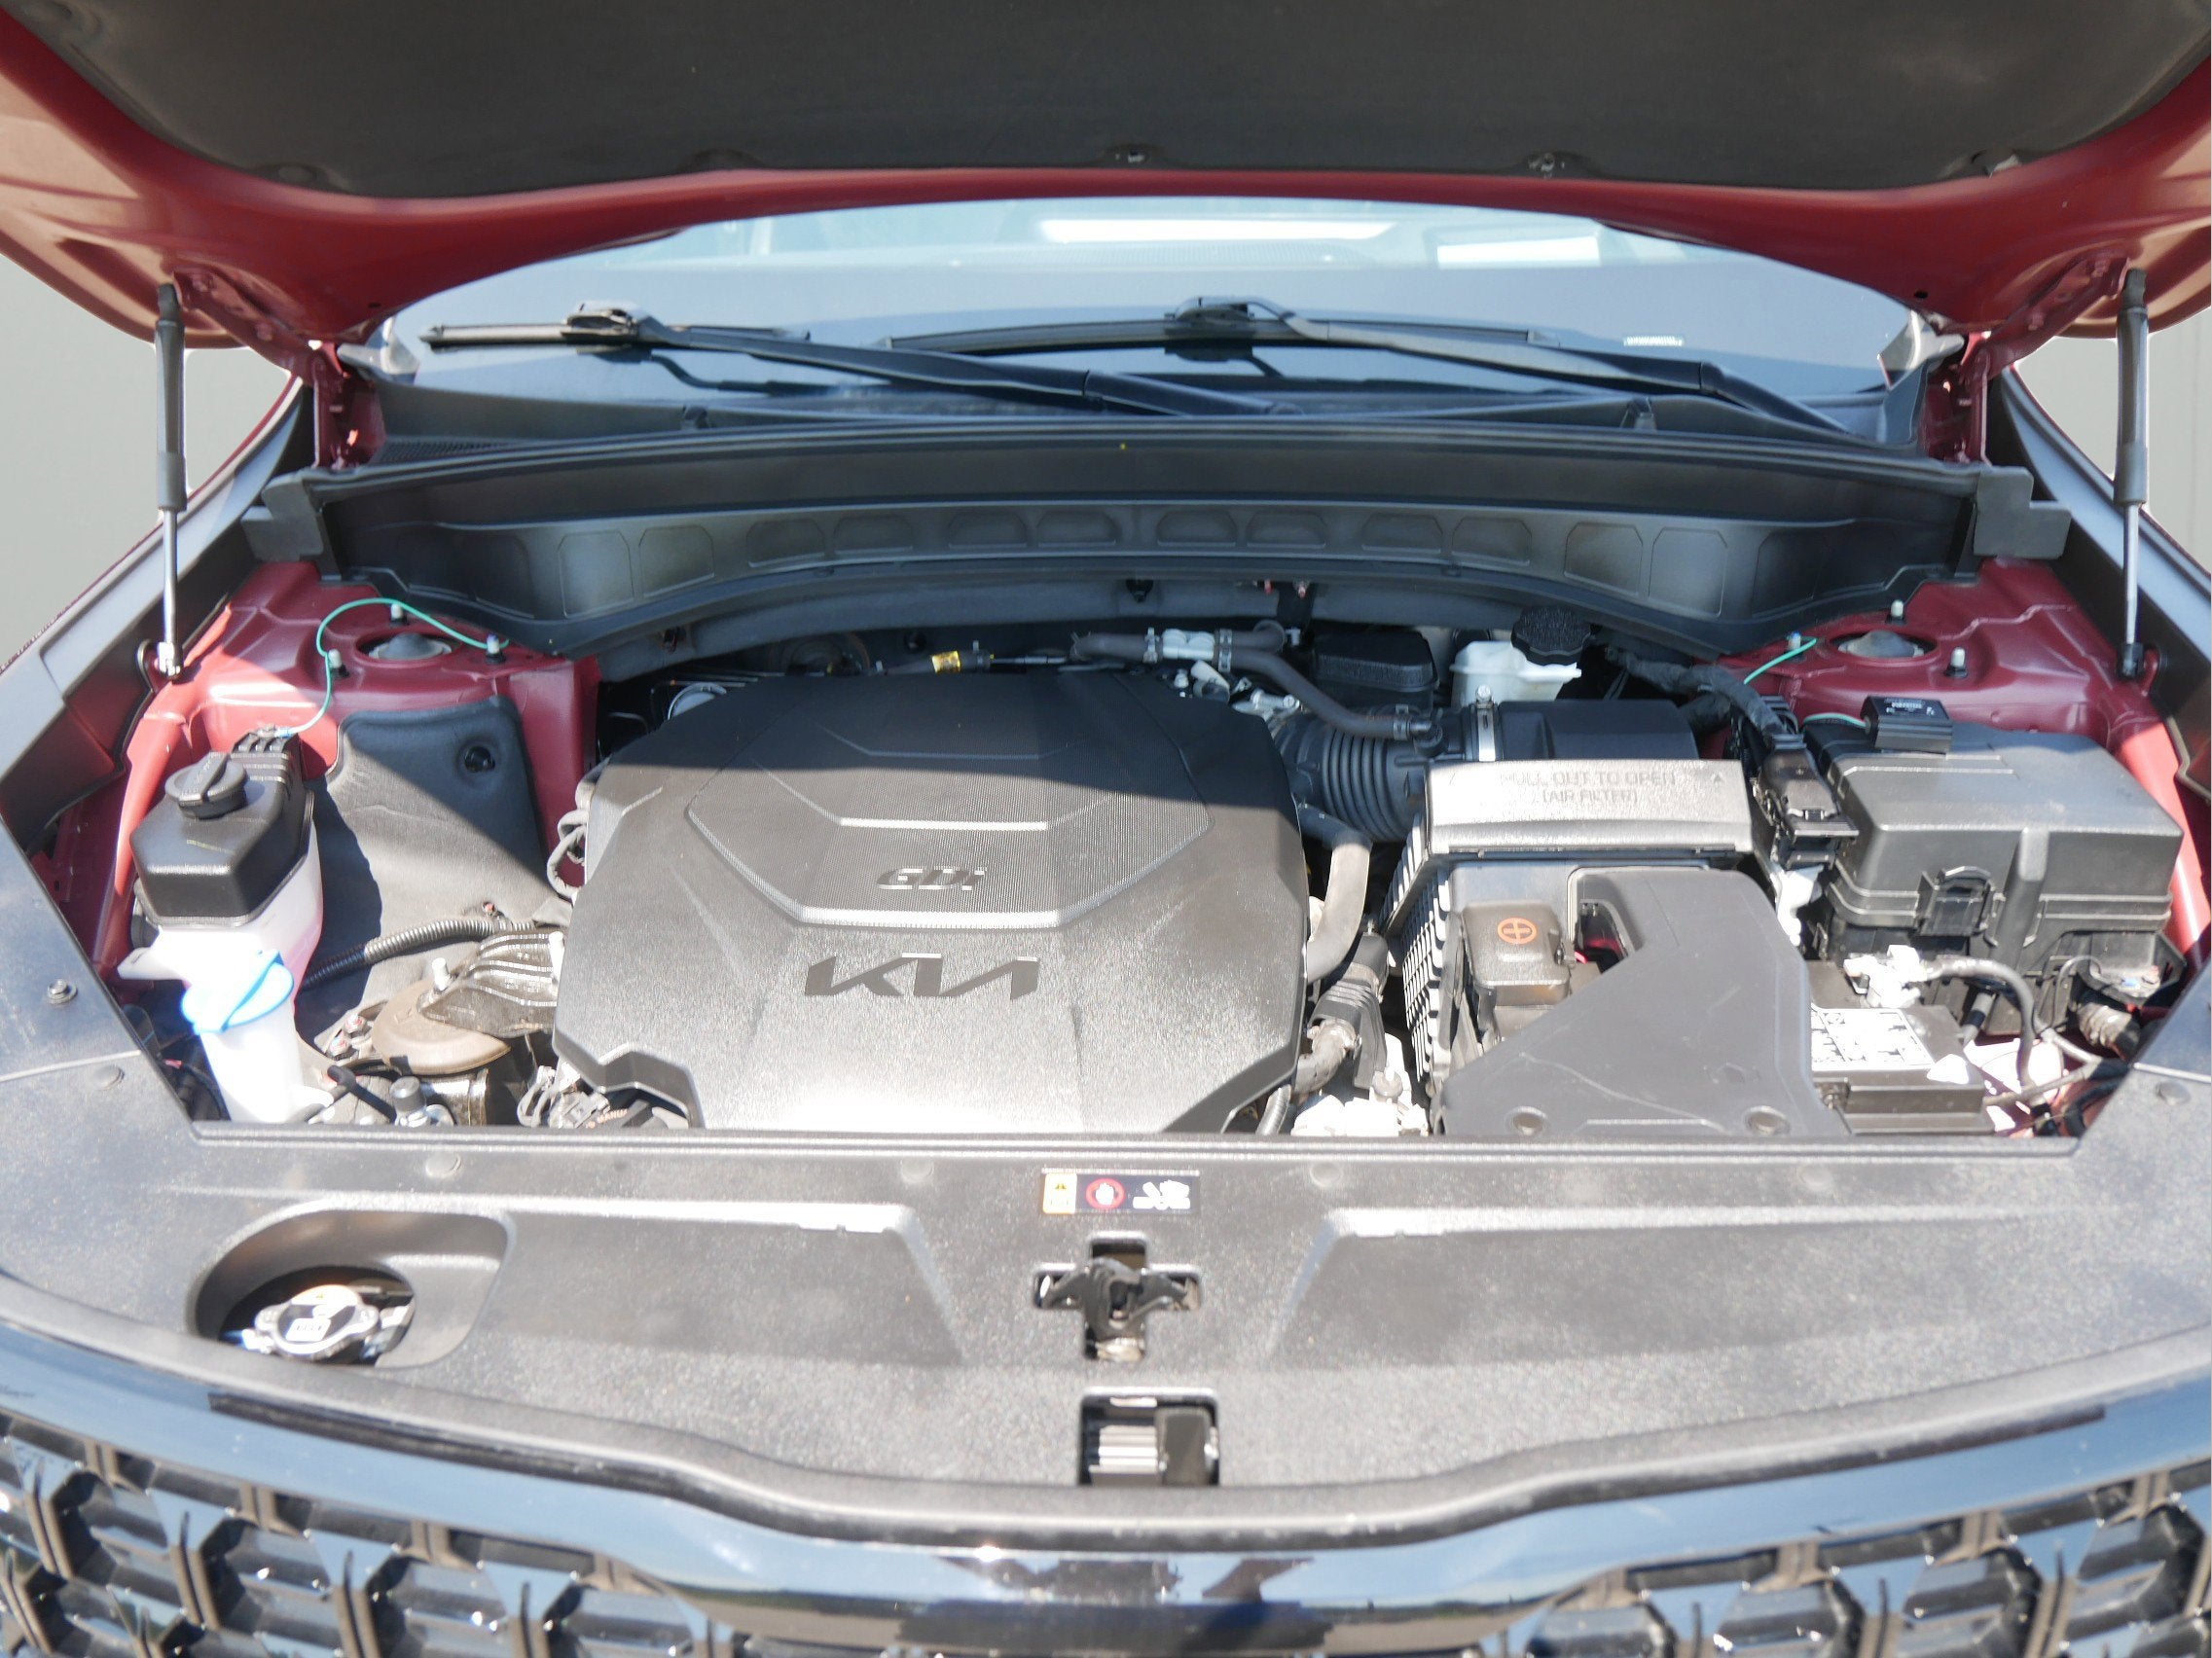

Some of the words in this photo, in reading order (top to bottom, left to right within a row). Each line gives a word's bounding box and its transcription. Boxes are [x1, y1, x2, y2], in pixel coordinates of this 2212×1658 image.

[1552, 771, 1590, 786] OUT
[1595, 771, 1620, 786] TO
[1624, 771, 1676, 786] OPEN
[804, 953, 1040, 1001] KIA
